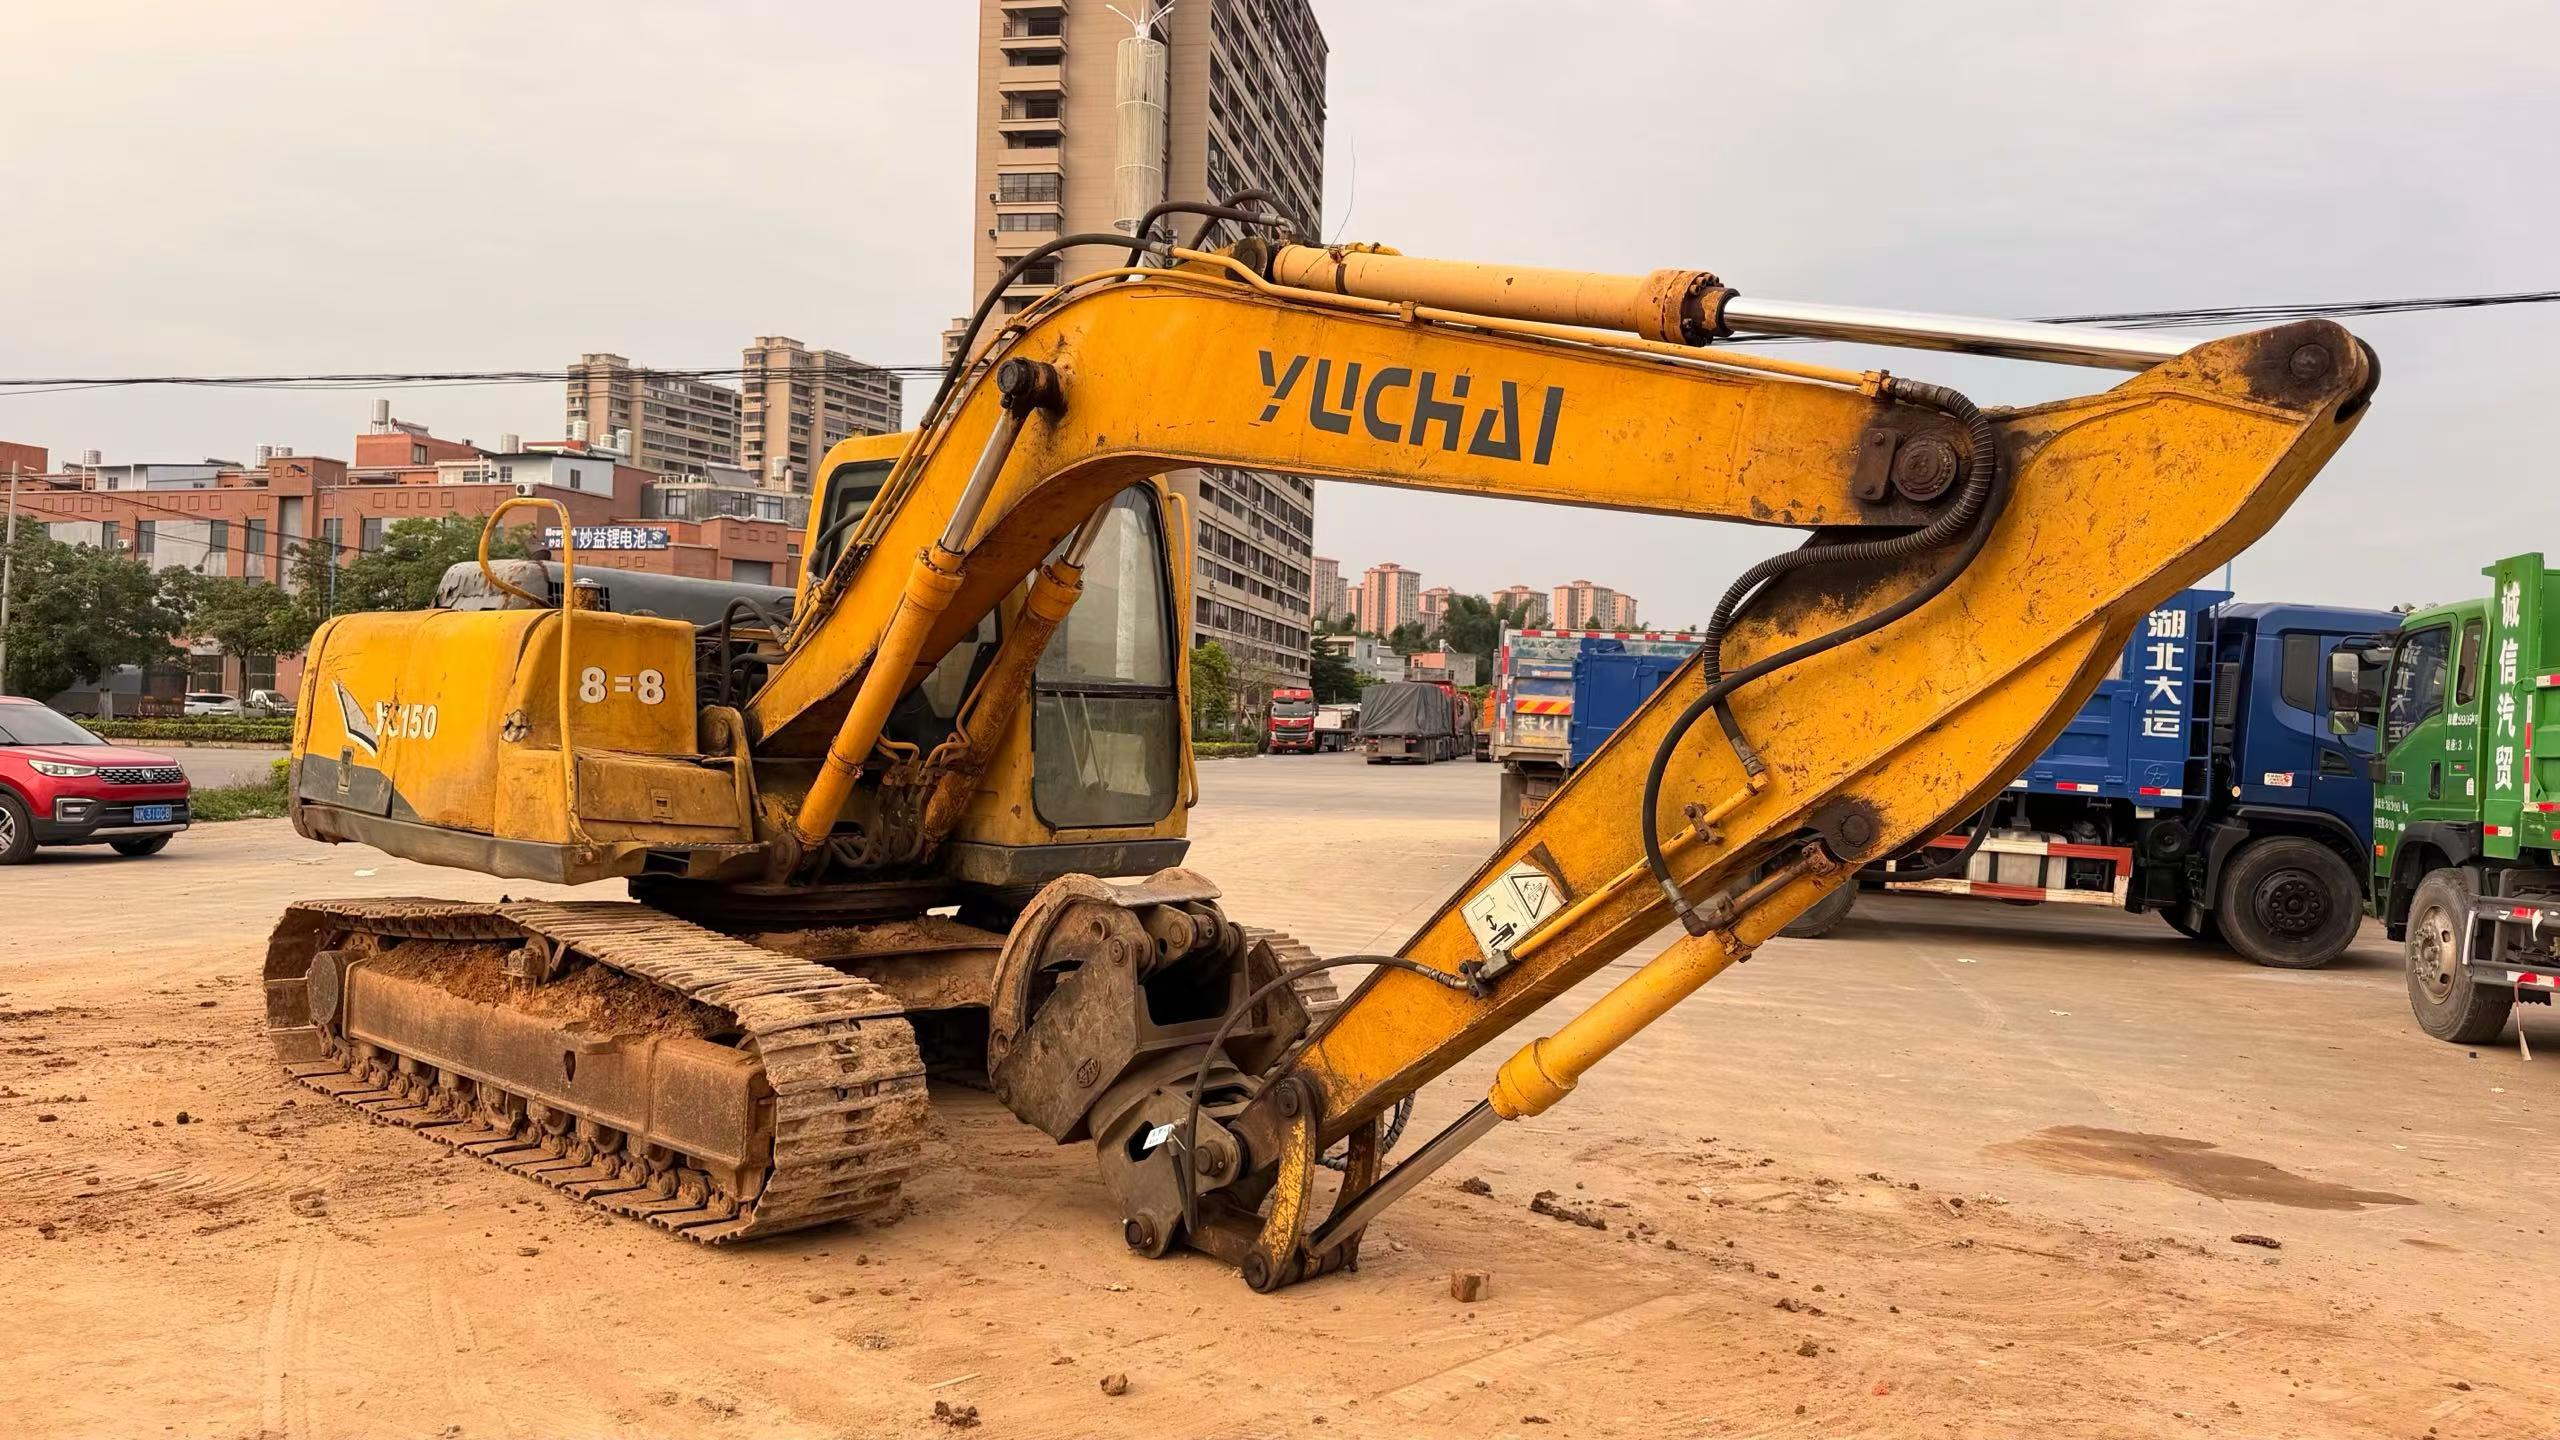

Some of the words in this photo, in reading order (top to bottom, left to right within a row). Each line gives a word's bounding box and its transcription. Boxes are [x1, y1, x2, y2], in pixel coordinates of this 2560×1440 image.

[1258, 350, 1565, 466] YUCHAI
[579, 527, 647, 549] 妙益锂电池
[580, 666, 665, 705] 8=8
[2141, 609, 2186, 738] 湖北大运
[2495, 580, 2520, 791] 诚信汽贸
[375, 700, 438, 740] YC150
